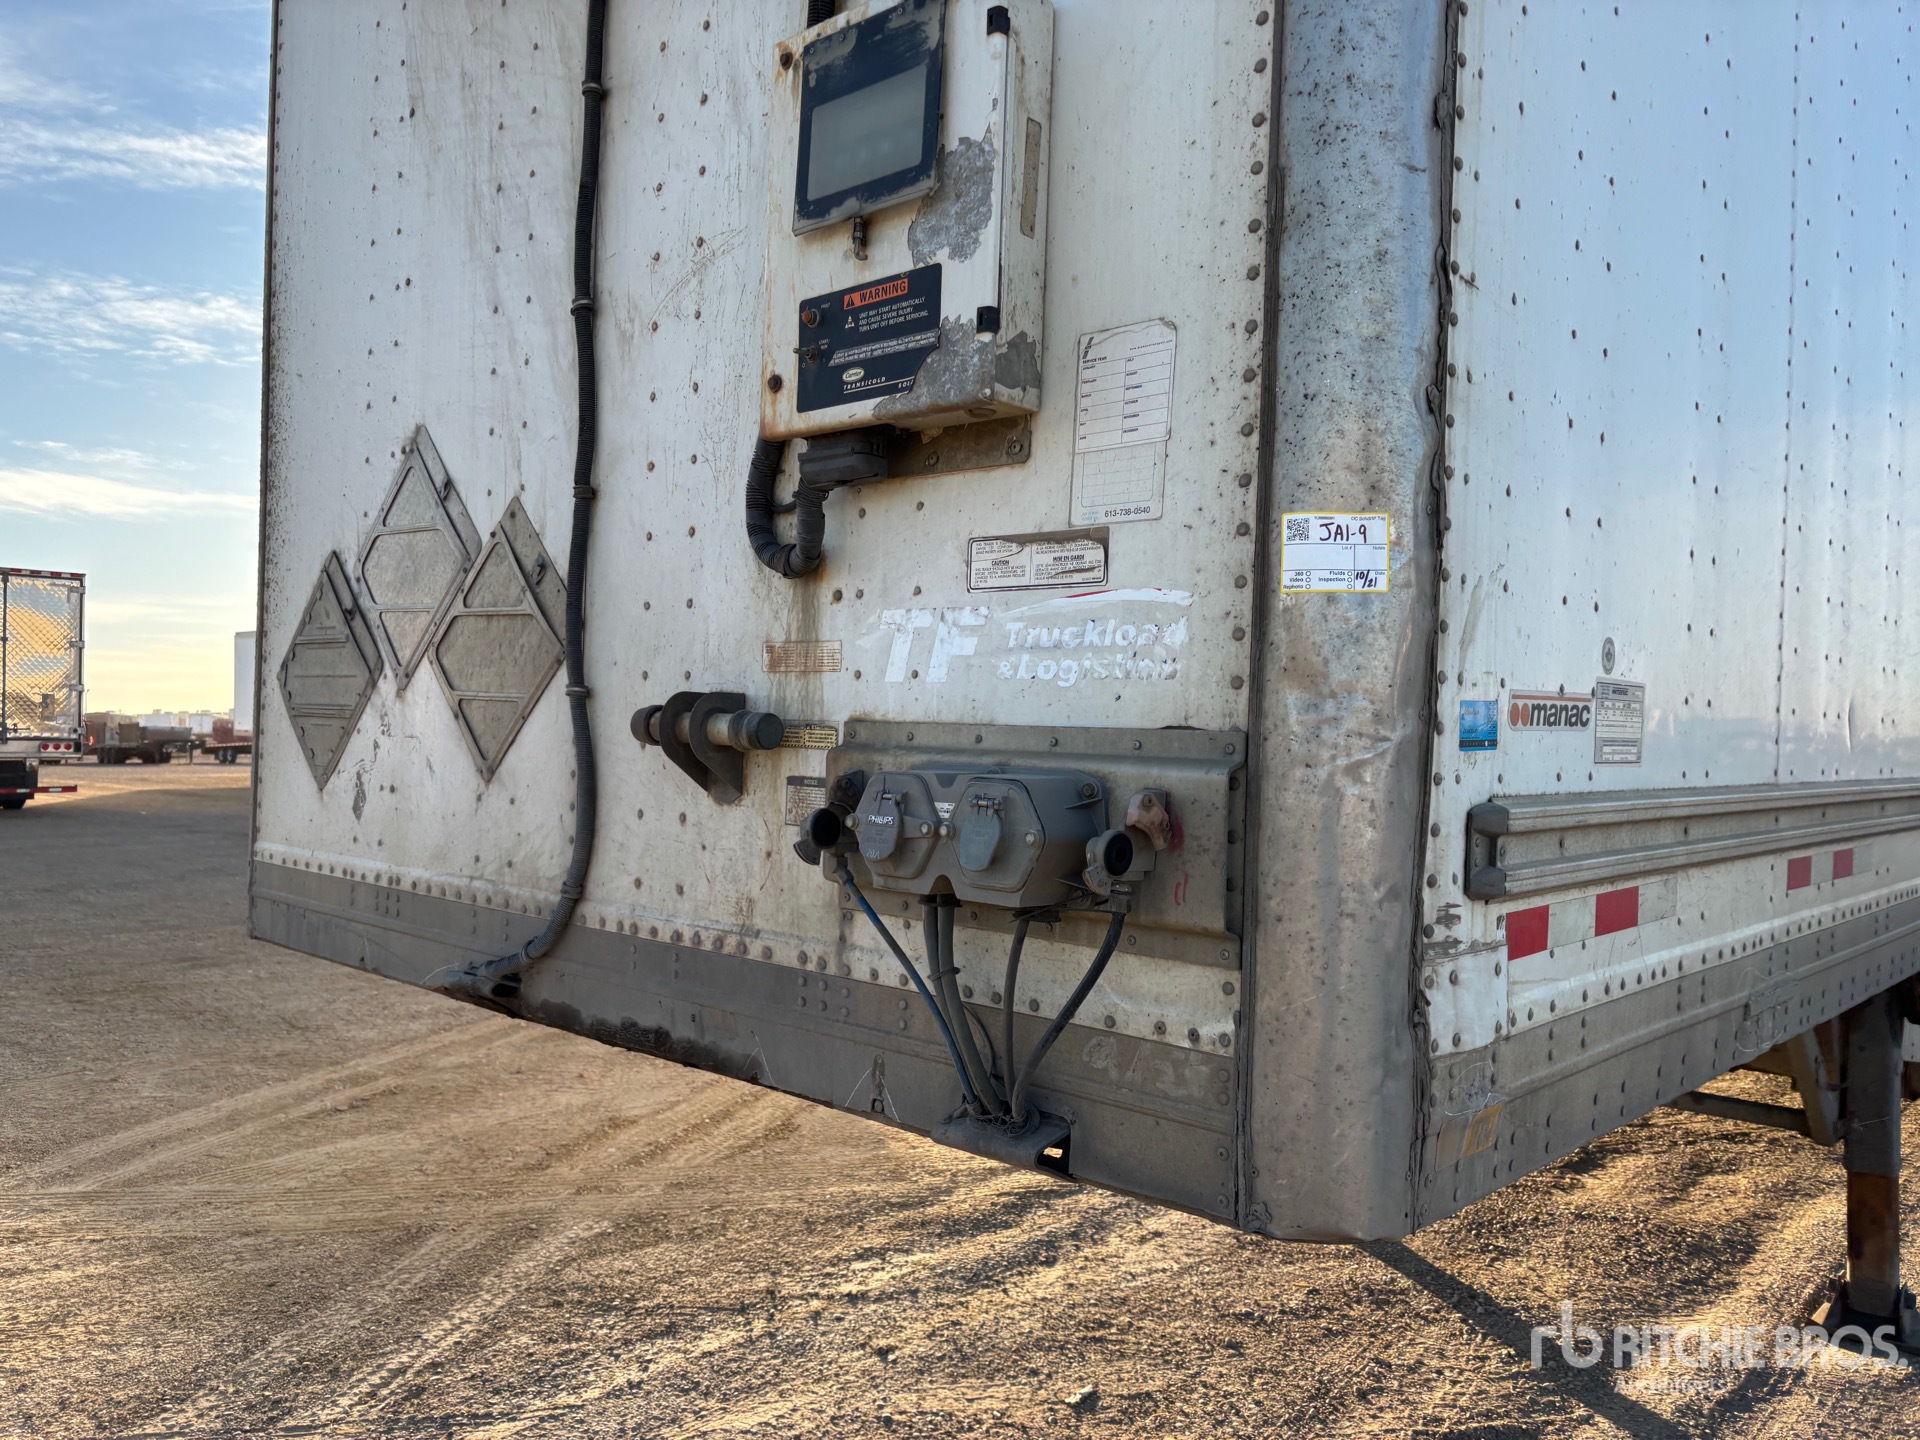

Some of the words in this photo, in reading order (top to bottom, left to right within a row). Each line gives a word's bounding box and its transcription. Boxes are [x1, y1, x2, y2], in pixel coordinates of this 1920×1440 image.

[859, 281, 906, 304] WARNING
[879, 305, 891, 314] START
[892, 296, 926, 310] AUTOMATICALLY
[868, 315, 882, 324] CAUSE
[882, 311, 898, 320] SEVERE
[889, 315, 905, 325] BEFORE
[843, 376, 886, 391] TRANSICOLD
[1104, 505, 1151, 518] 613-738-0540
[991, 559, 1010, 567] CAUTION
[1005, 615, 1189, 649] Truckload
[1529, 703, 1591, 728] manac
[868, 814, 894, 825] PHILLIPS
